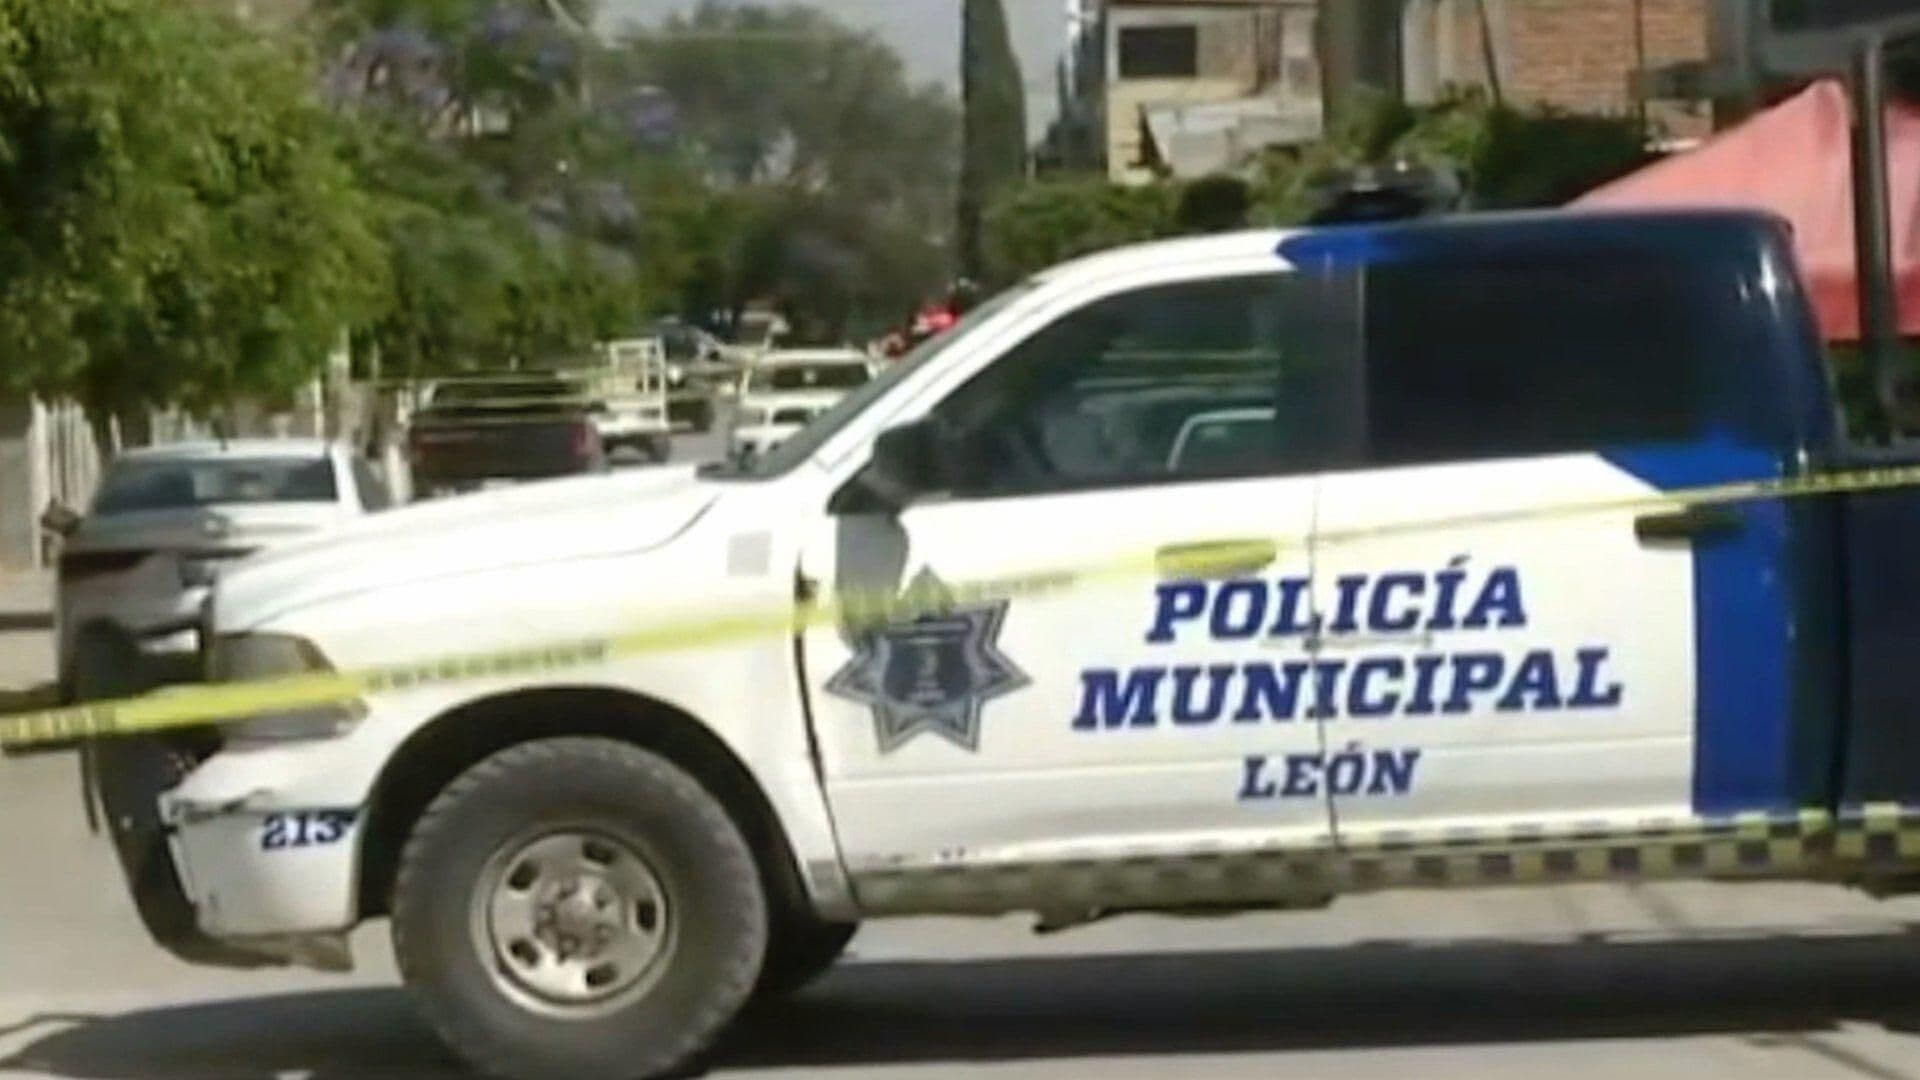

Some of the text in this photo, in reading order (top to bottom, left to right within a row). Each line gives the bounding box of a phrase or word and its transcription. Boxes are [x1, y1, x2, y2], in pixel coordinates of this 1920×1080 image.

[1145, 553, 1528, 643] POLICÍA
[1071, 647, 1624, 731] MUNICIPAL
[1238, 743, 1420, 800] LEÓN
